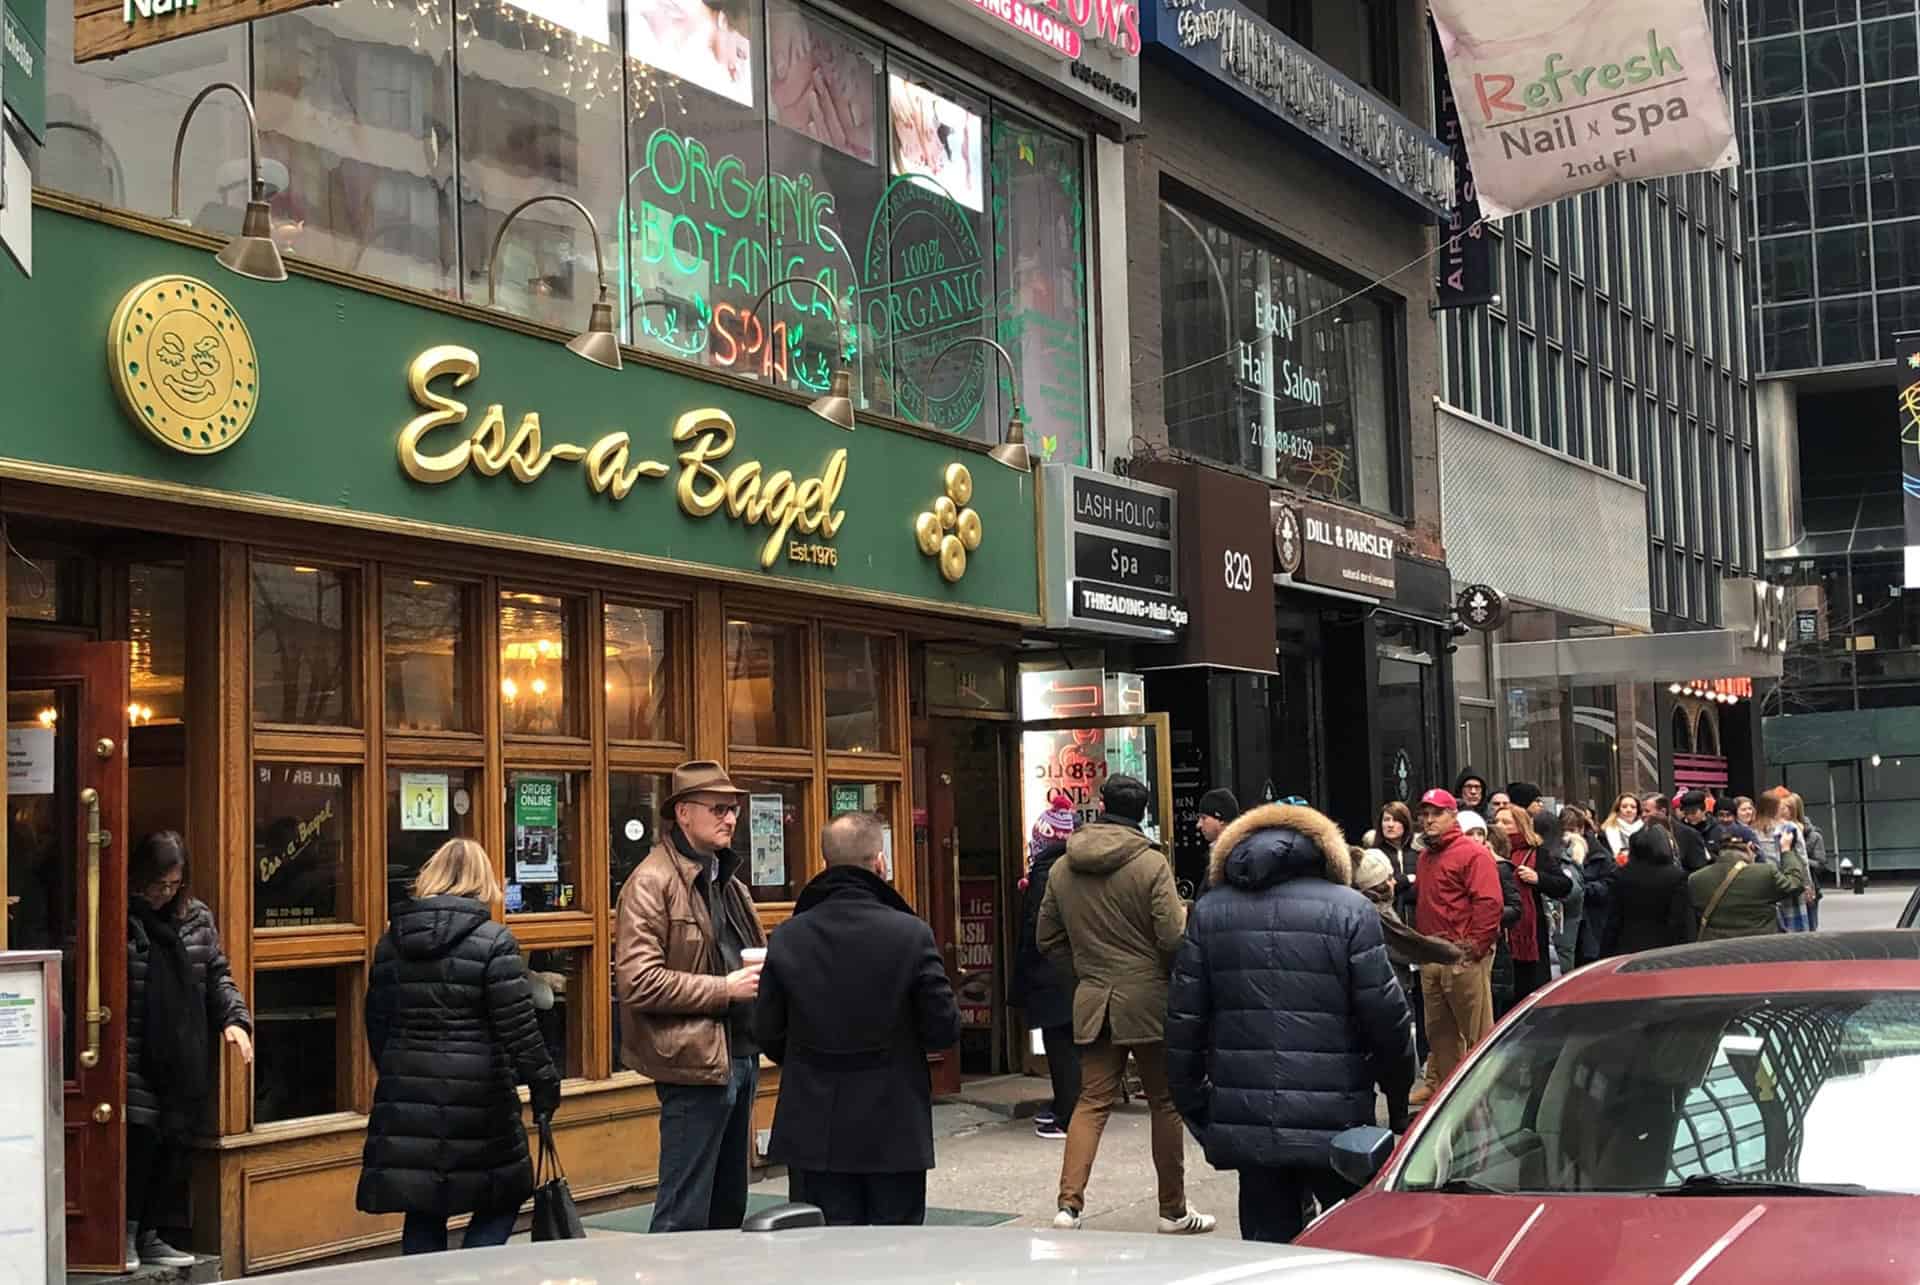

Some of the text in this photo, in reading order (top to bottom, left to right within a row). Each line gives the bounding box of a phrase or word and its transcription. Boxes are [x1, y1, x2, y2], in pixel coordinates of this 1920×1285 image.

[124, 0, 198, 24] Na
[1014, 3, 1071, 52] SALON!
[1474, 28, 1684, 121] Refresh
[1501, 115, 1576, 160] Nail
[1611, 97, 1689, 136] Spa
[1562, 154, 1607, 178] 2nd
[647, 128, 835, 252] ORGANIC
[901, 239, 945, 277] 100%
[868, 268, 987, 339] ORGANIC
[714, 302, 788, 382] SPA
[1240, 341, 1321, 407] Hai Salon
[399, 345, 848, 568] Ess-a-Bagel
[1076, 490, 1155, 529] LASH HOLIC
[1306, 518, 1333, 545] DILL
[1335, 525, 1344, 548] &
[1345, 529, 1393, 560] PARSLEY
[1111, 547, 1139, 579] Spa
[1224, 550, 1253, 592] 829
[520, 783, 552, 794] ORDER
[1072, 761, 1107, 779] 831
[520, 794, 552, 807] ONLINE
[835, 791, 858, 801] ORDER
